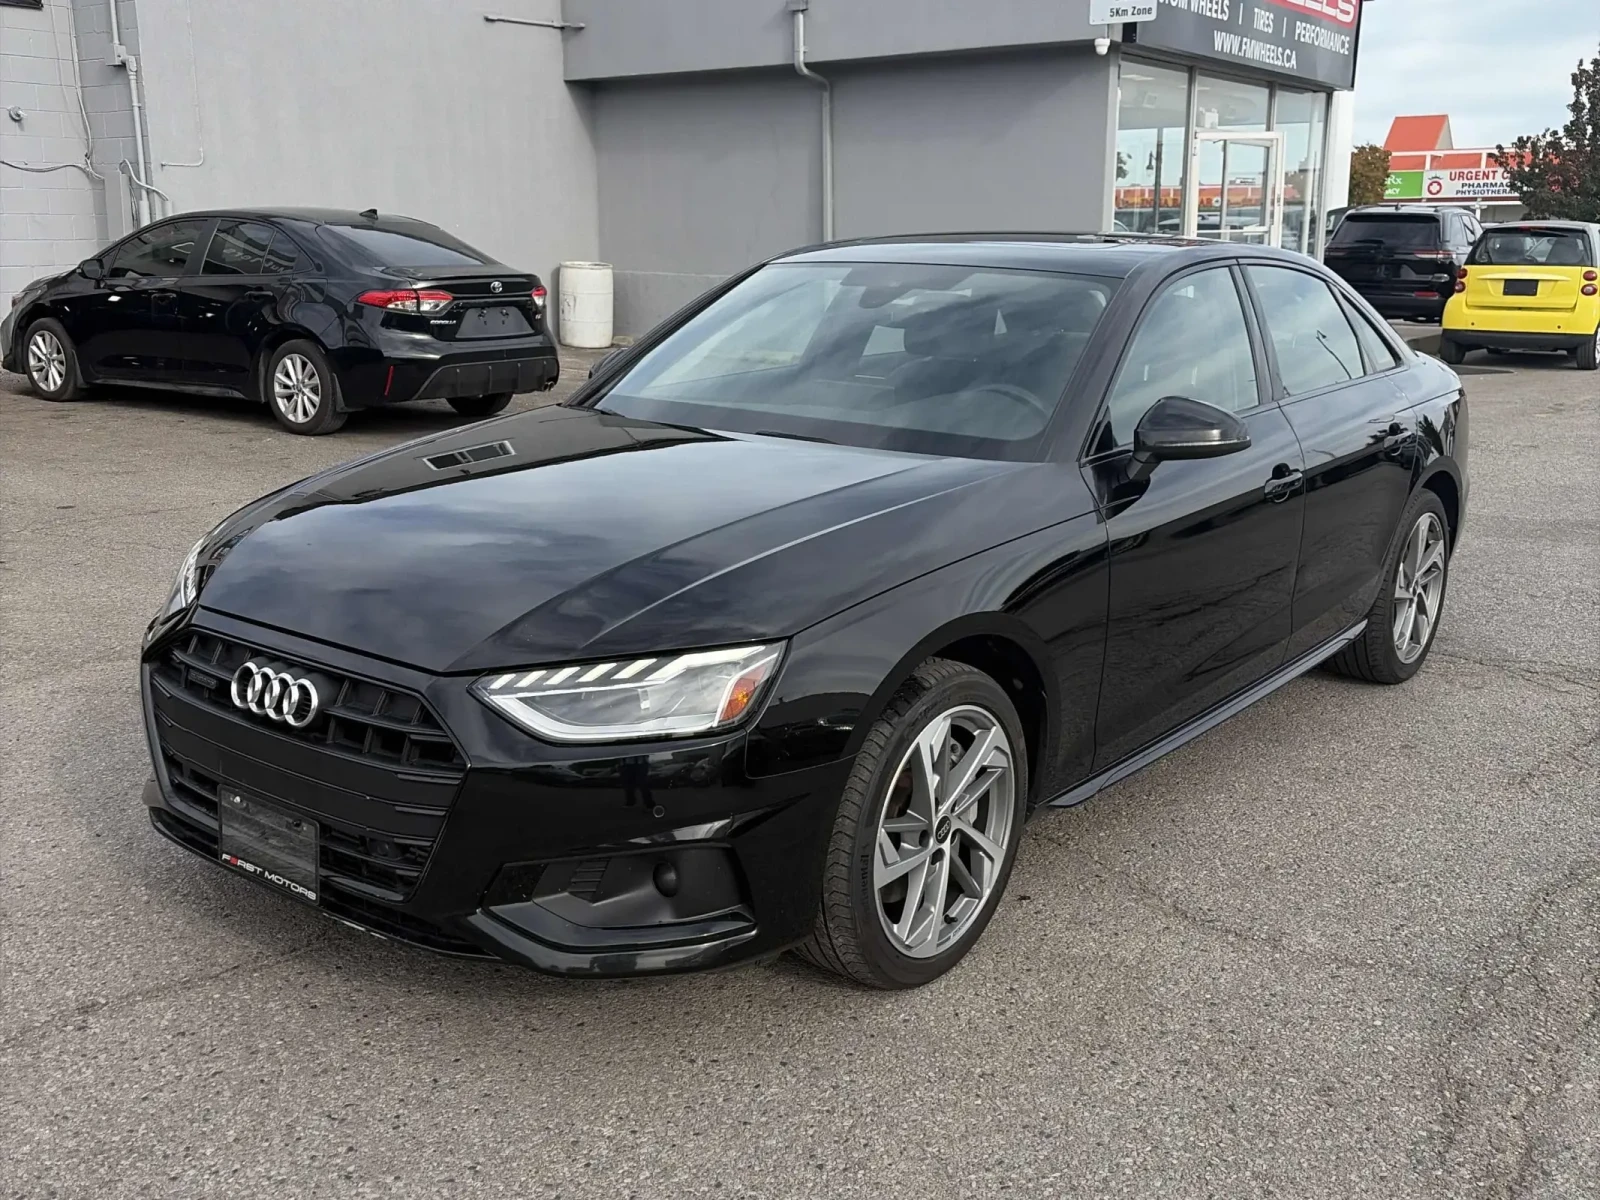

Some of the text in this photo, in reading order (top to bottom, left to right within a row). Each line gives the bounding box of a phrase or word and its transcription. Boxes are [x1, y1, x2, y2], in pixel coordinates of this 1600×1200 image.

[1131, 6, 1153, 16] Zone
[1253, 7, 1274, 33] TIRES
[1295, 21, 1350, 55] PERFORMANCE
[1214, 30, 1297, 69] WWW.FMWHEELS.CA
[1449, 170, 1498, 181] URGENT
[1455, 188, 1515, 196] PHYSIOTHERA
[264, 870, 317, 901] MOTORS
